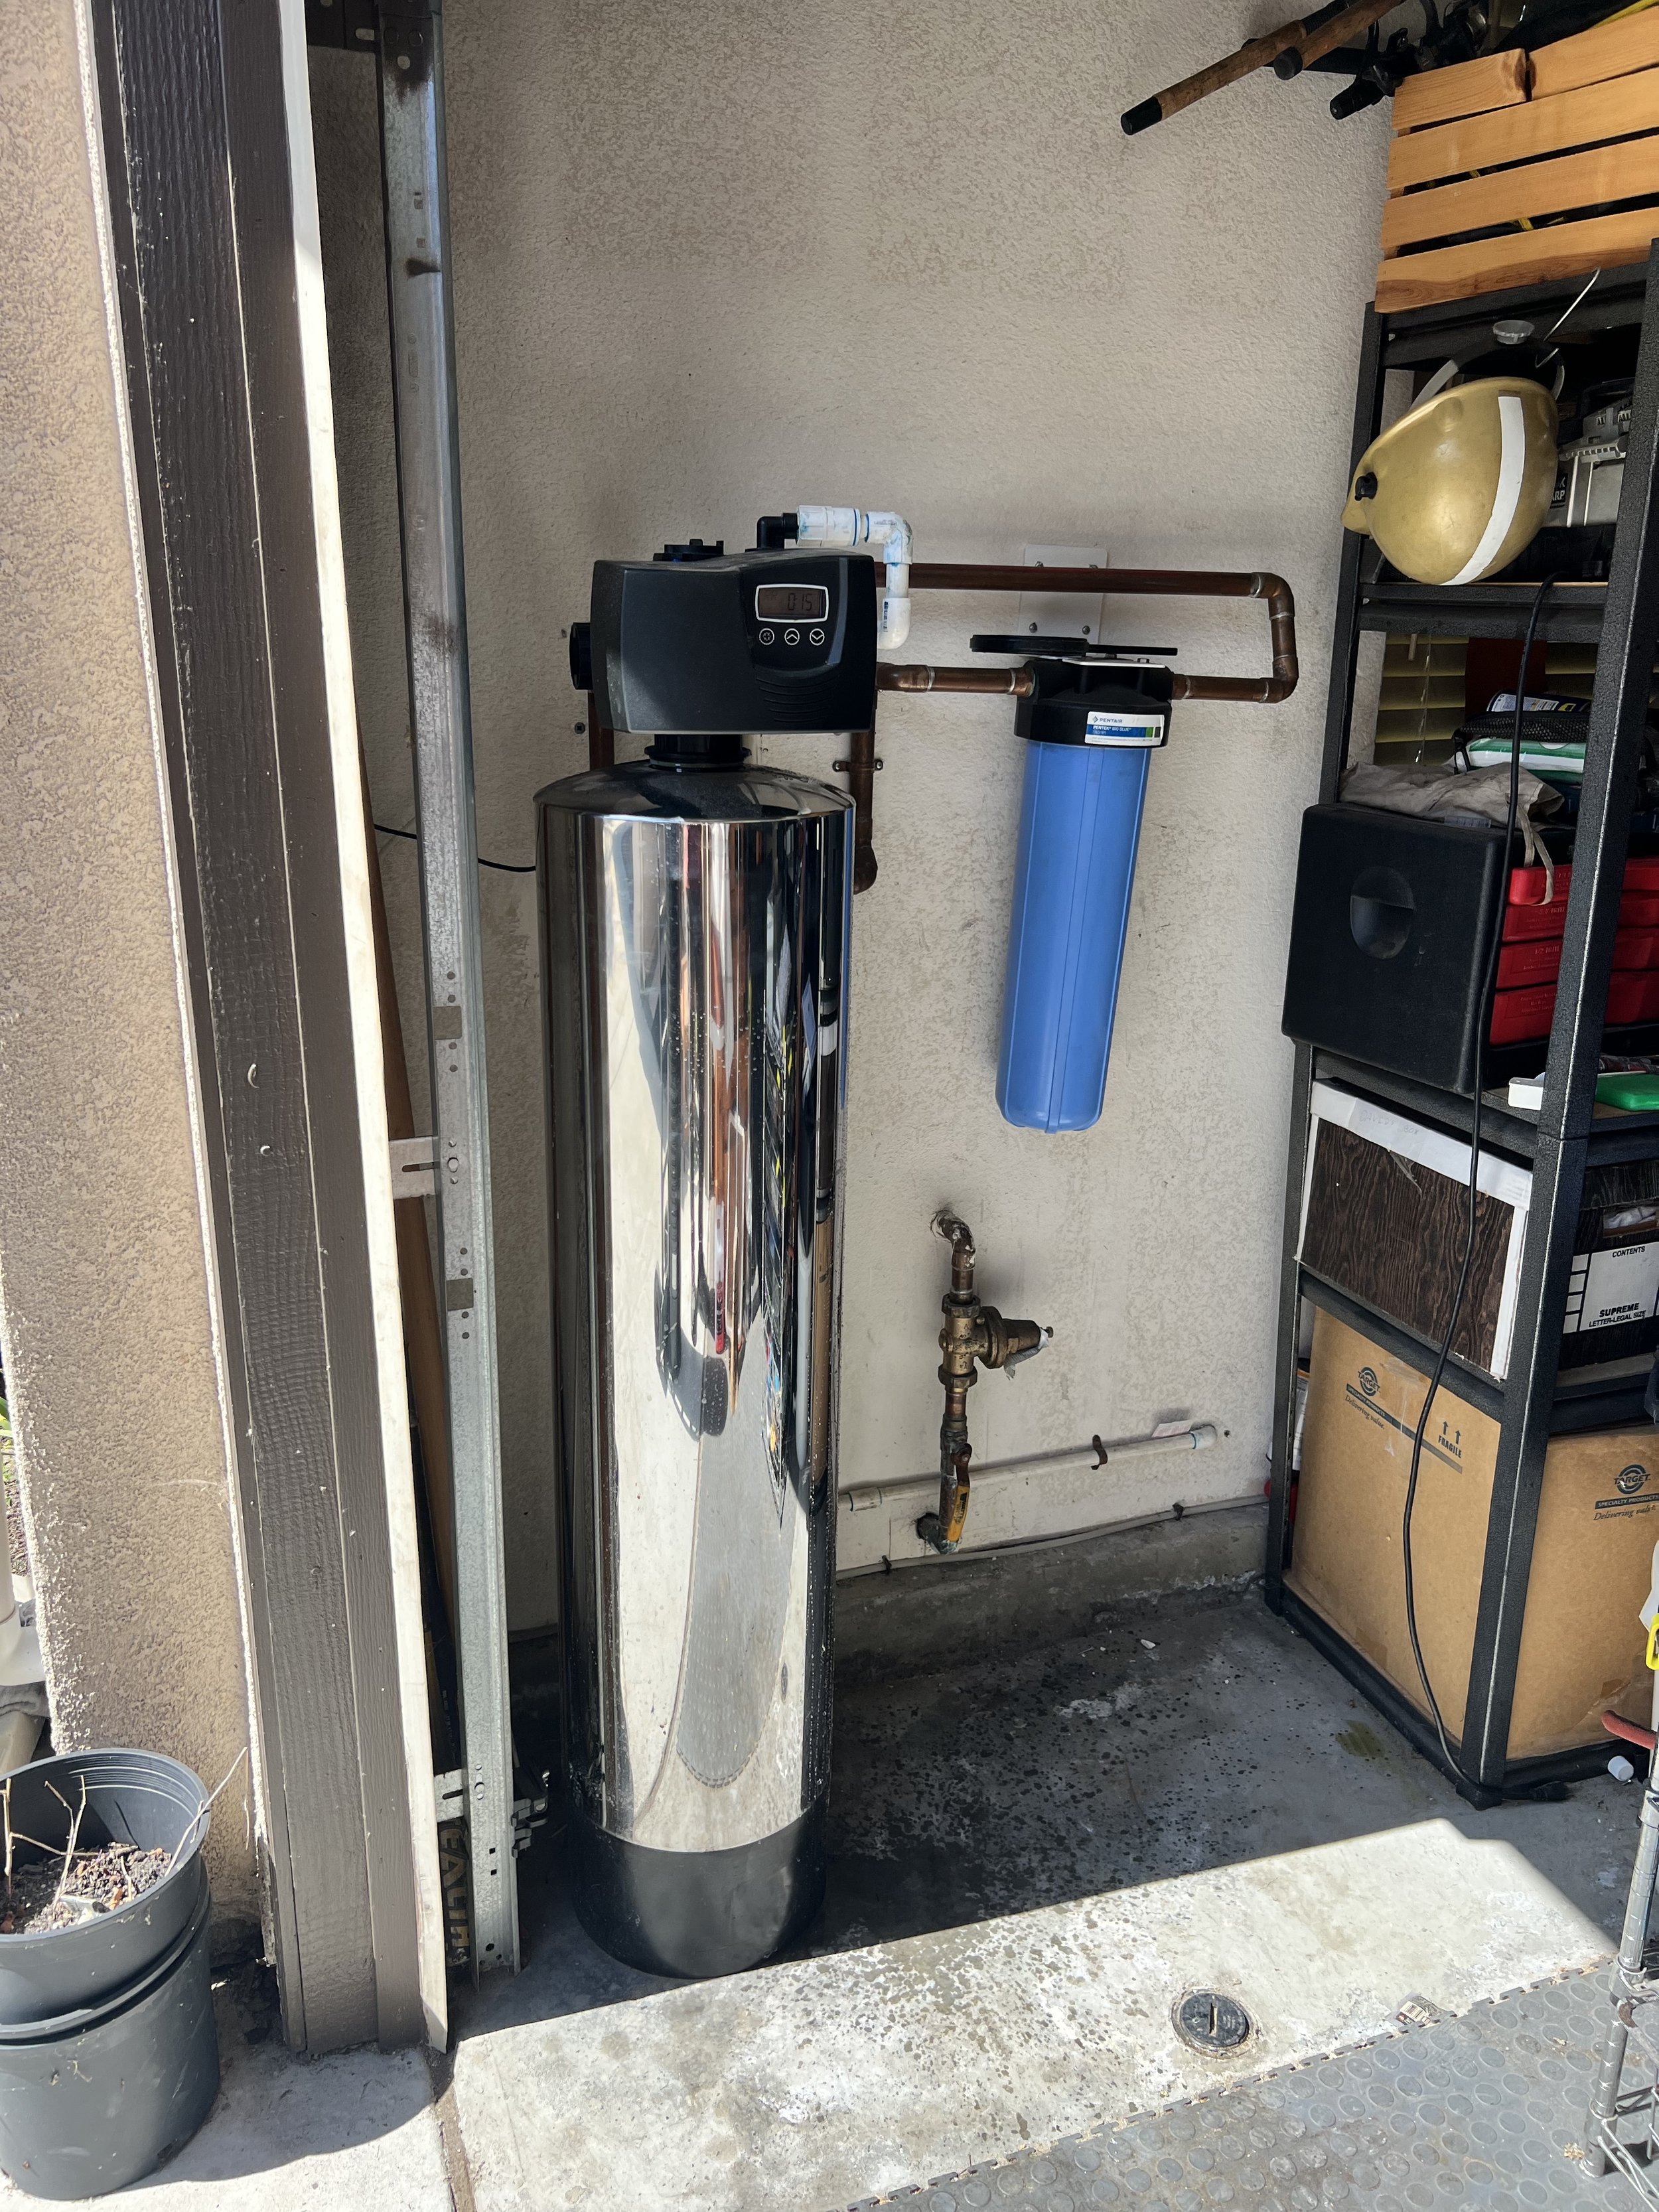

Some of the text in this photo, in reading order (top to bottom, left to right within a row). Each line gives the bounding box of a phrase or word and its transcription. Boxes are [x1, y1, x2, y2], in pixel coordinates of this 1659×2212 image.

[1612, 1246, 1646, 1258] CONTENTS
[1599, 1302, 1640, 1317] SUPREME
[1589, 1310, 1646, 1327] LETTER-LEGAL SIZE
[1358, 1370, 1381, 1392] TARGET
[1344, 1394, 1370, 1420] Delivering
[1438, 1434, 1462, 1459] FRAGILE
[1613, 1473, 1651, 1485] TARGET
[1597, 1495, 1658, 1508] SPECIALTY PRODUCTS
[1593, 1510, 1635, 1520] Delivering
